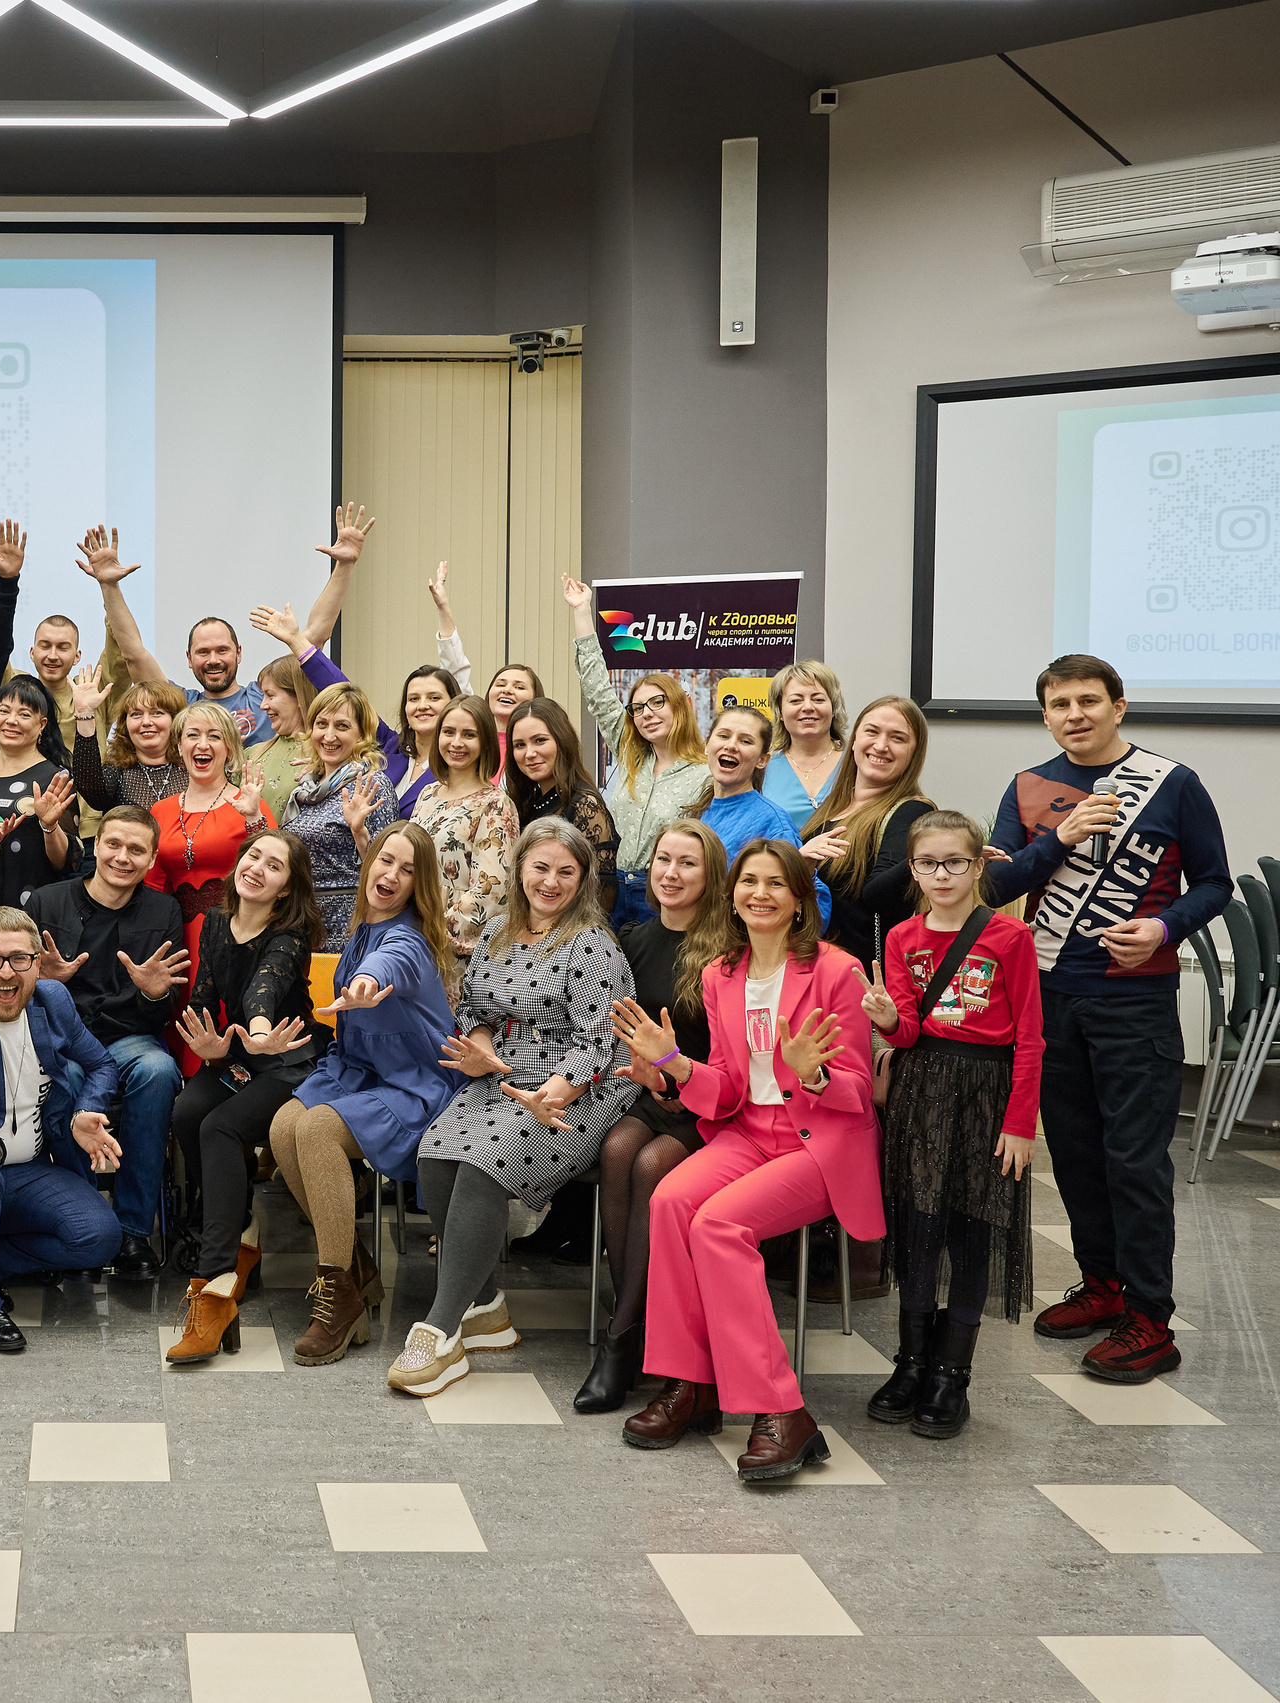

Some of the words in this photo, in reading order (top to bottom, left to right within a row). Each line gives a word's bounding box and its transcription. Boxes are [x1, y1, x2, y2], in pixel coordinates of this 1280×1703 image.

[708, 615, 718, 626] к
[704, 637, 754, 647] АКАДЕМИЯ
[756, 636, 794, 646] СПОРТА
[742, 698, 770, 707] ЛЫЖ
[1076, 832, 1166, 948] SINCE
[966, 1003, 985, 1014] SOFIE
